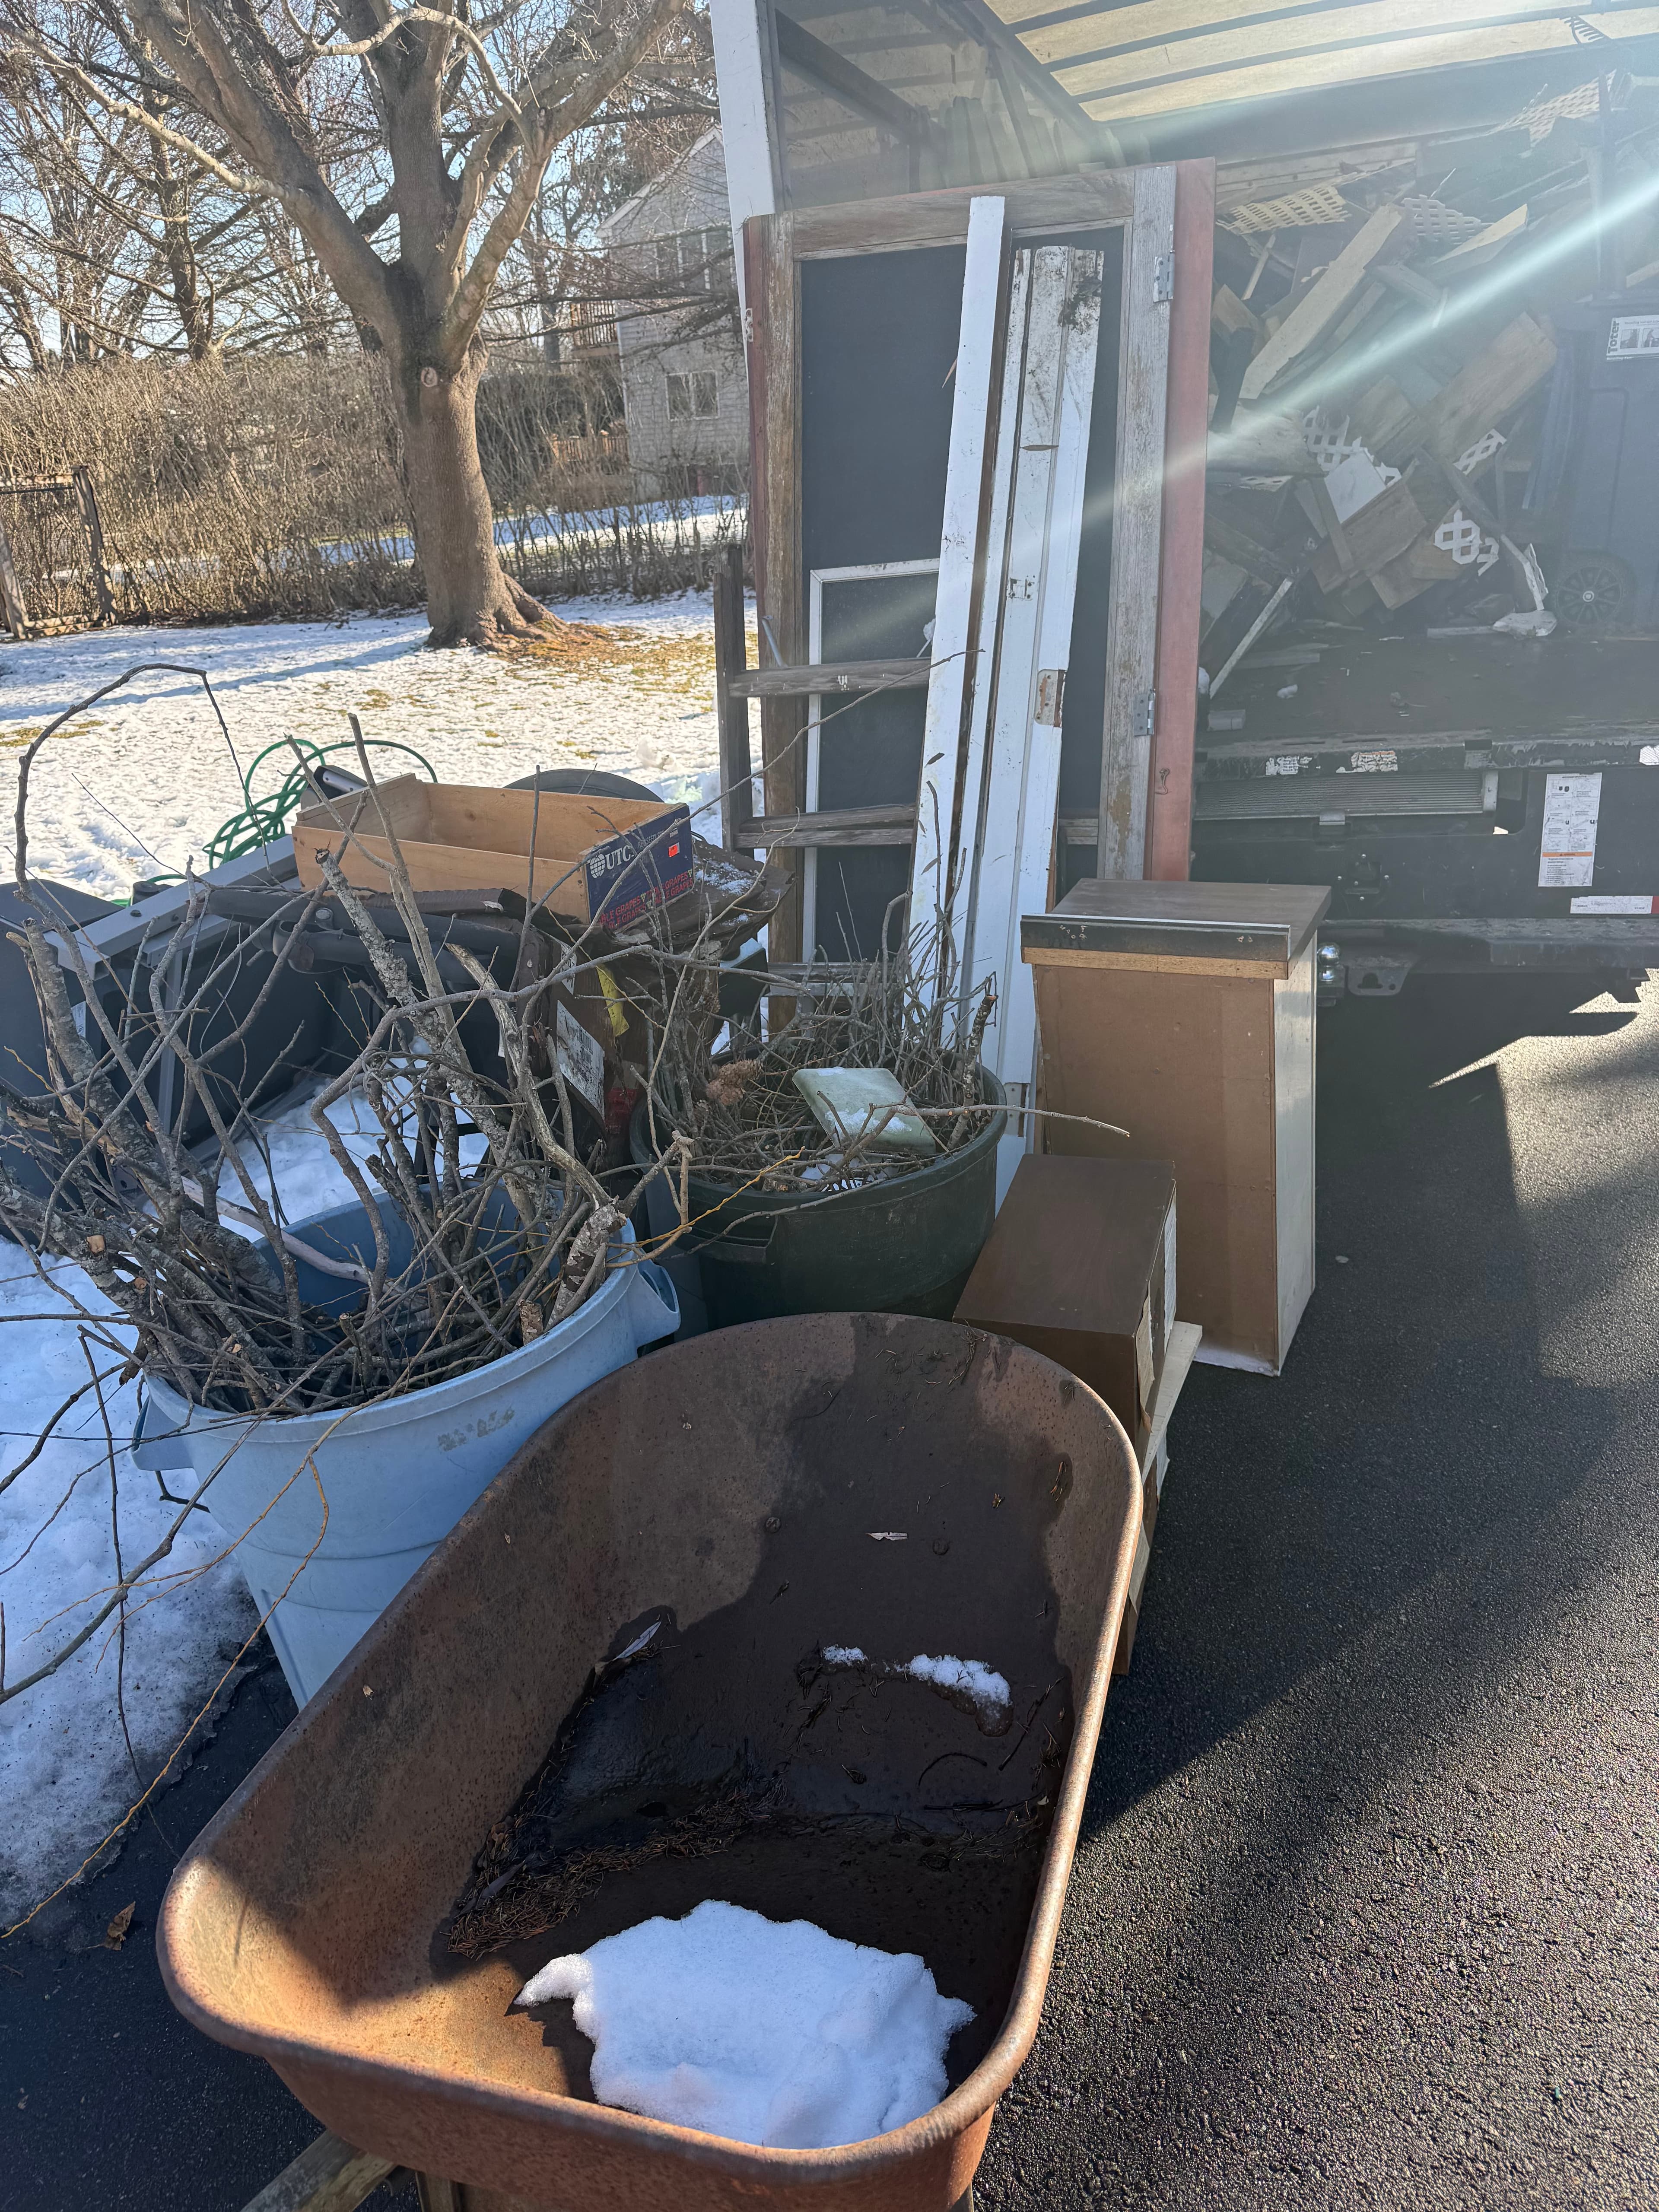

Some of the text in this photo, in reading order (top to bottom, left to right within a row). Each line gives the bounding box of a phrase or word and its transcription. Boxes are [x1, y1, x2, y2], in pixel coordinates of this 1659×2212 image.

[1608, 321, 1619, 353] Toter
[605, 845, 631, 870] UTC
[615, 896, 641, 916] GRAPES
[664, 871, 688, 890] GRAPES
[671, 878, 693, 896] GRAPES
